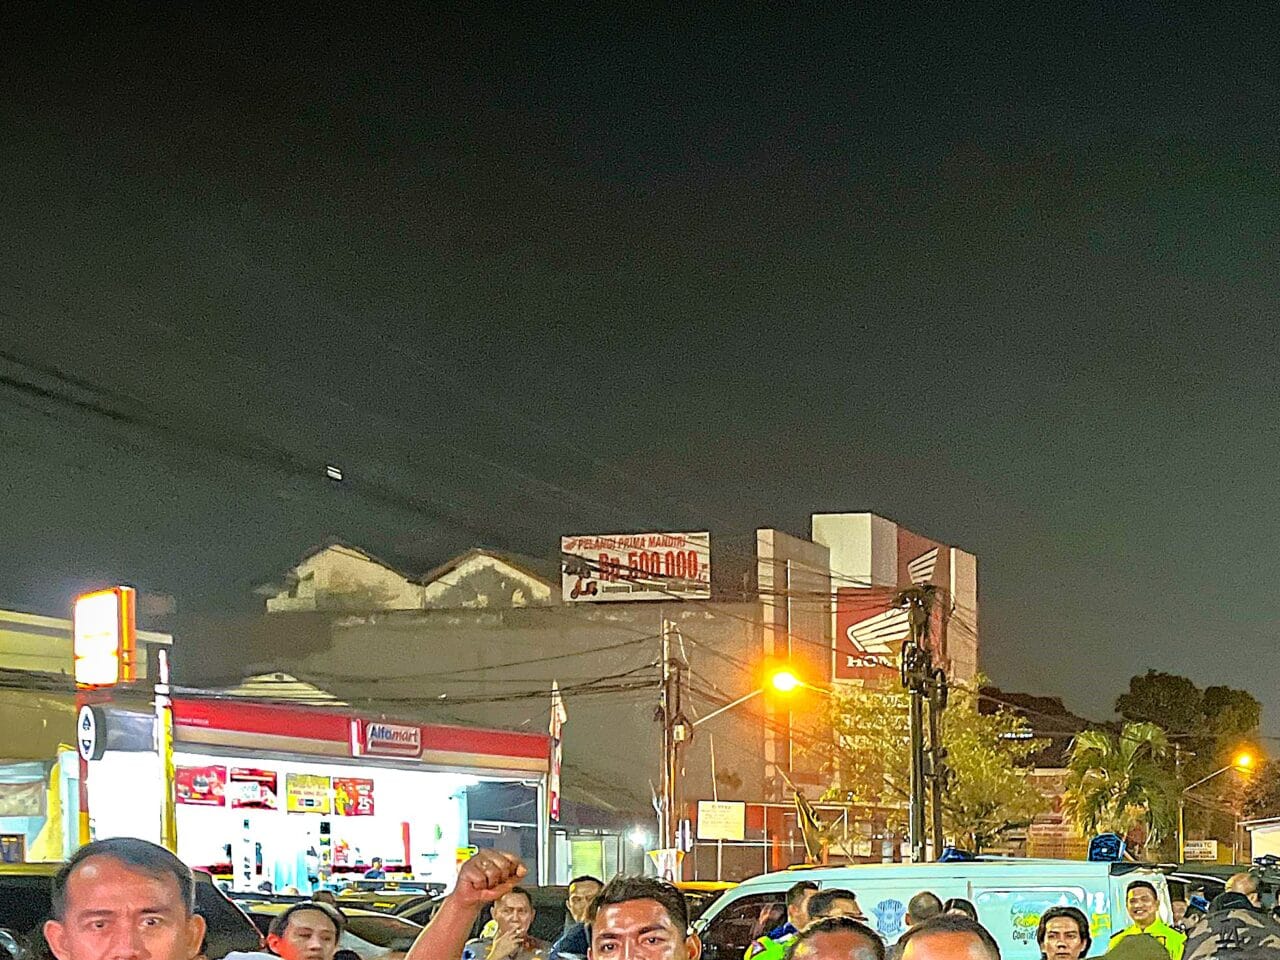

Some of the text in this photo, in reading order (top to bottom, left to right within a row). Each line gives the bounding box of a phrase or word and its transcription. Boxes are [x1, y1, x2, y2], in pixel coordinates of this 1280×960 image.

[618, 536, 646, 549] PRIMA
[649, 535, 686, 548] MANDIRI
[847, 655, 902, 668] HON
[371, 723, 418, 743] Alfamart
